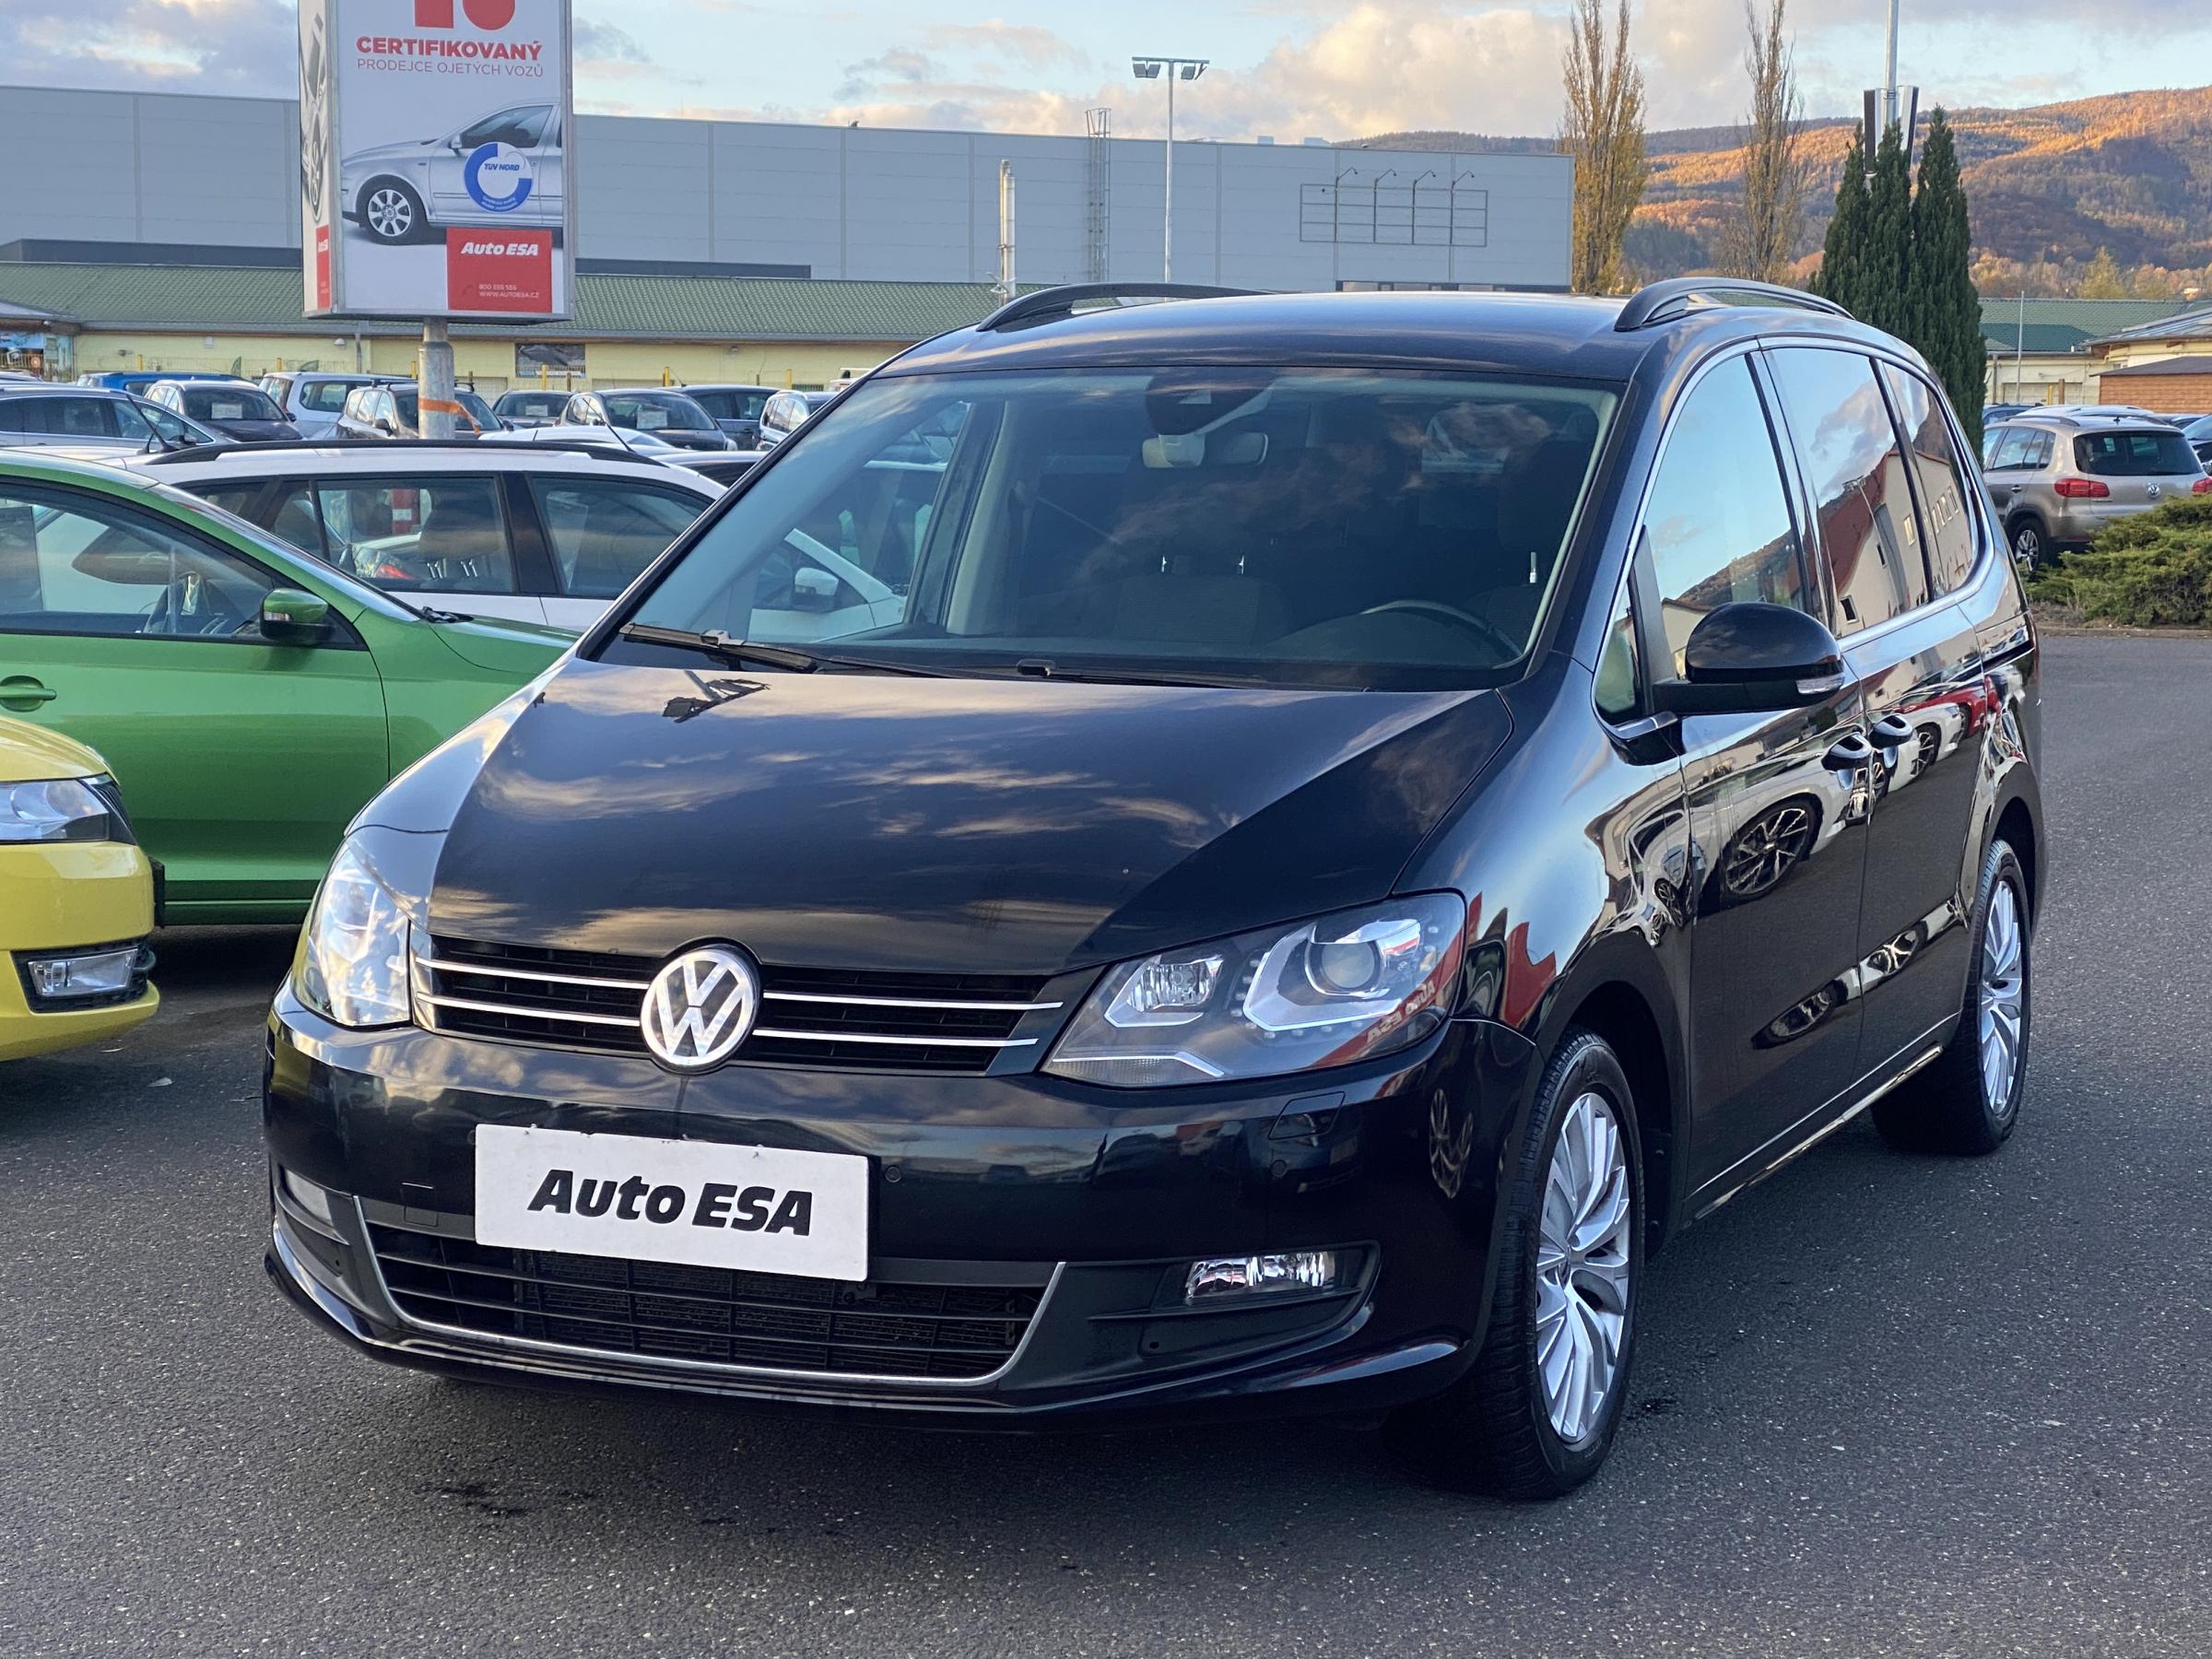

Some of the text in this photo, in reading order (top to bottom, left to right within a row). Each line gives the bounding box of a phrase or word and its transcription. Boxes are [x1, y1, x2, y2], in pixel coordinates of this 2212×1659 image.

[356, 36, 543, 61] CERTIFIKOVANÝ
[358, 58, 544, 77] PRODEJCE OJETÝCH VOZŮ
[499, 163, 520, 171] NORD
[461, 241, 538, 256] Auto ESA
[527, 1169, 813, 1236] Auto ESA
